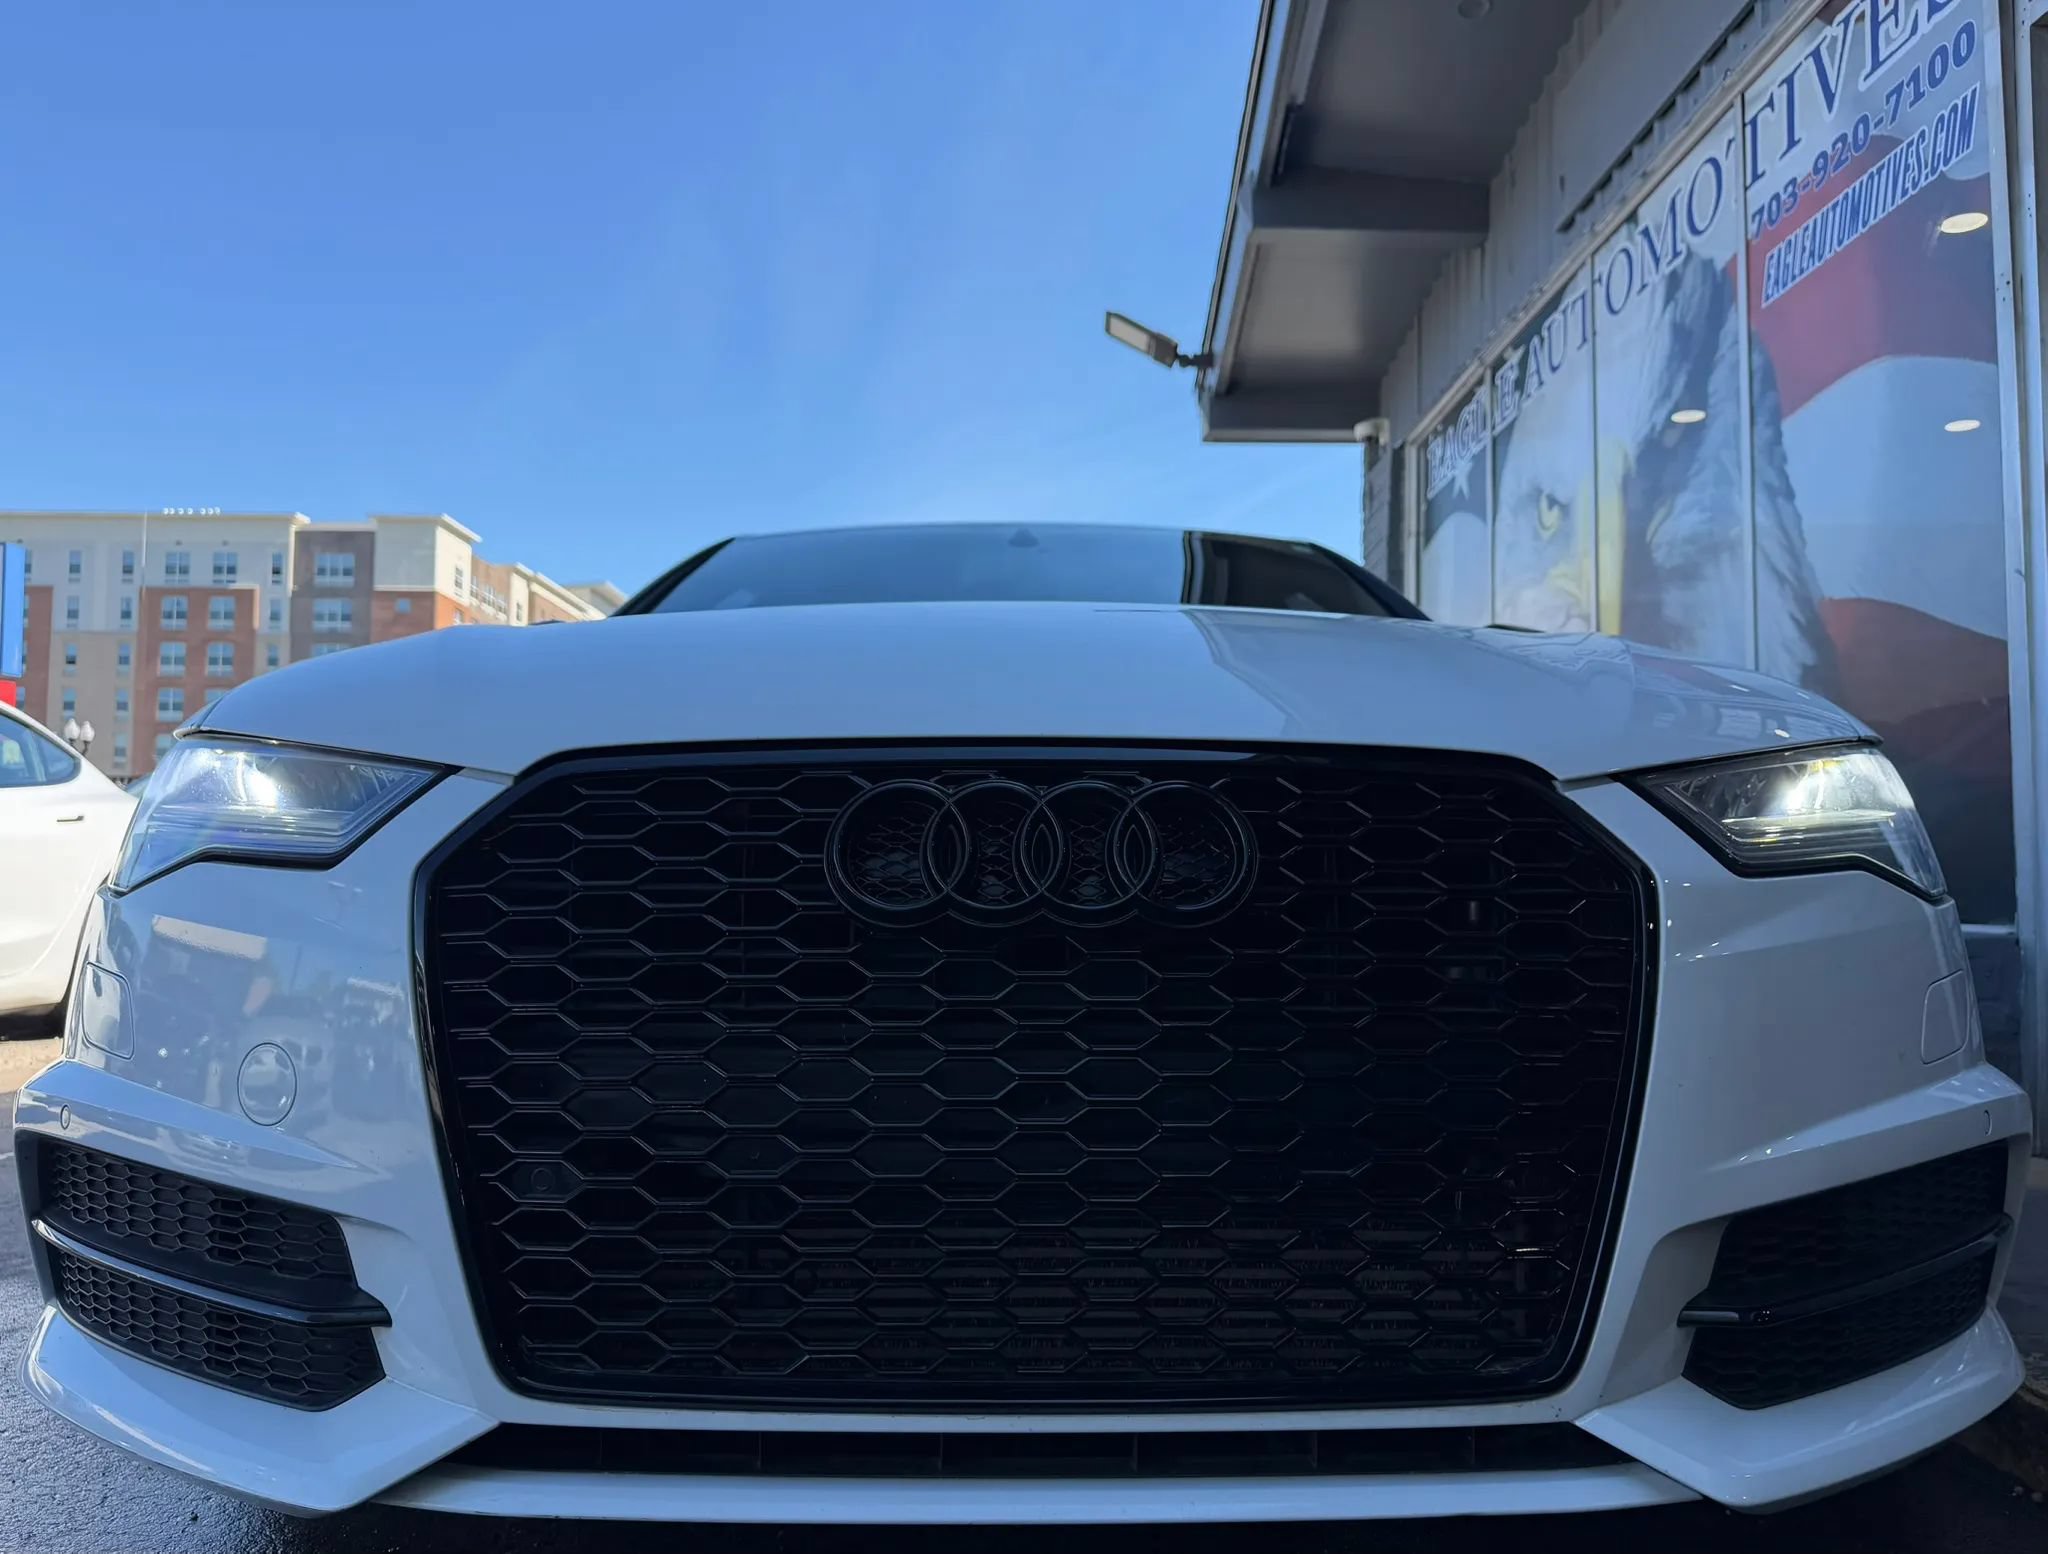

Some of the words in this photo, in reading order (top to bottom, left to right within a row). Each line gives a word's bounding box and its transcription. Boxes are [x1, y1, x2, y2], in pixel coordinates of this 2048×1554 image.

[1751, 20, 1976, 237] 703-920-7100
[1764, 83, 1979, 305] EAGLEAUTOMOTIVES.COM
[1429, 358, 1521, 495] EAGLE
